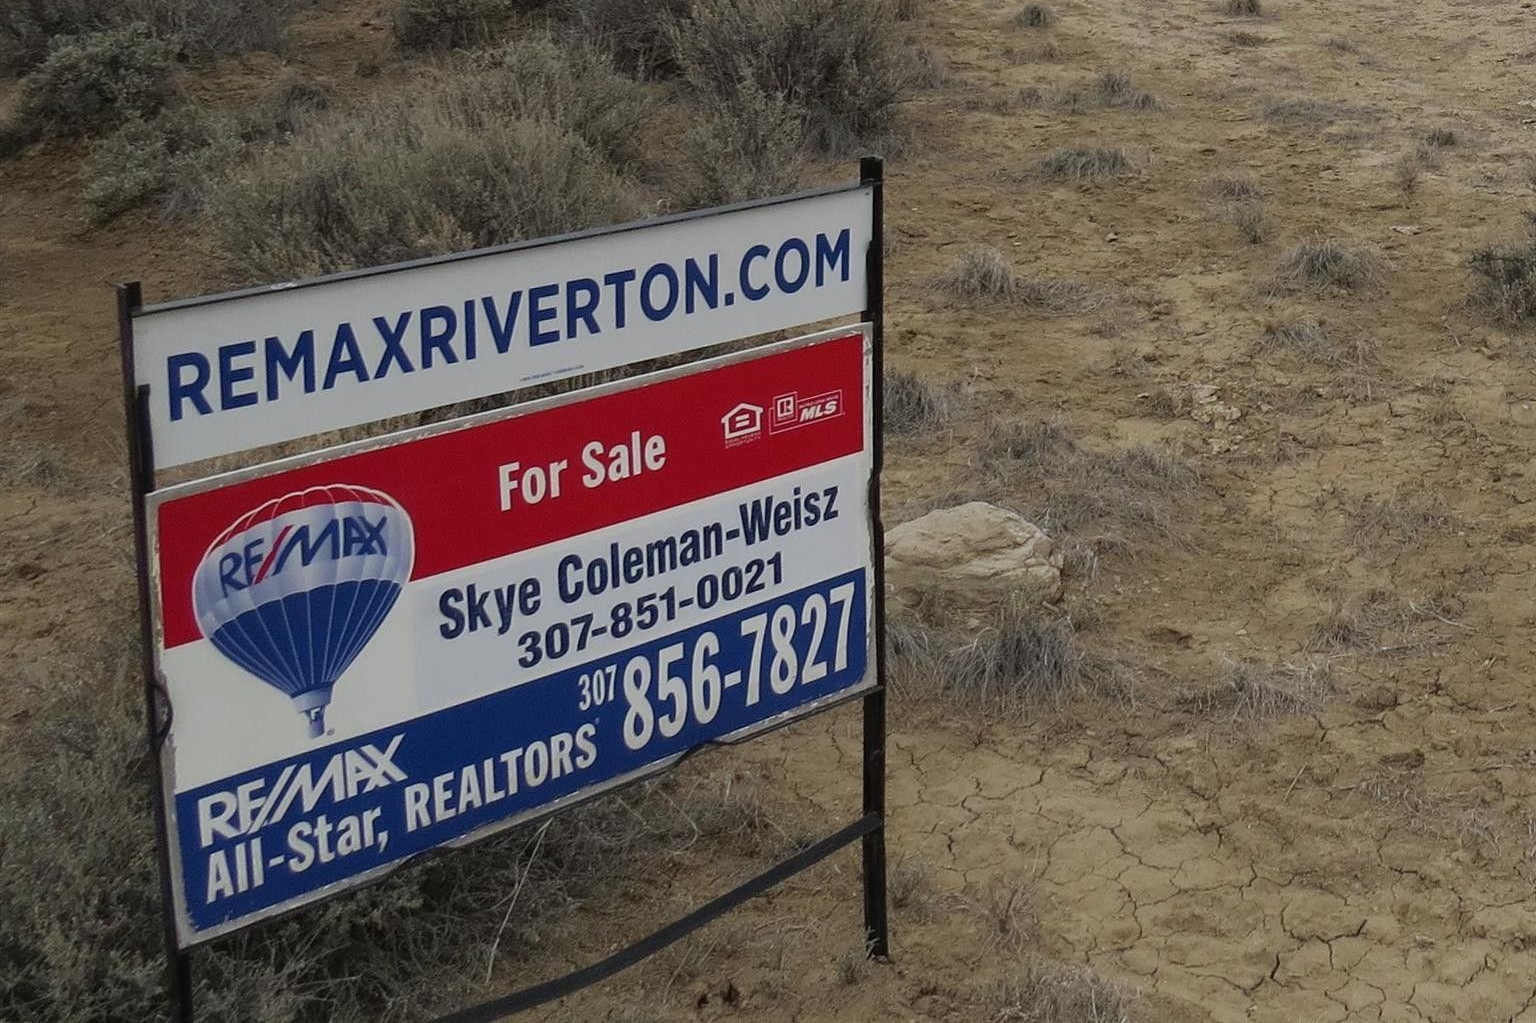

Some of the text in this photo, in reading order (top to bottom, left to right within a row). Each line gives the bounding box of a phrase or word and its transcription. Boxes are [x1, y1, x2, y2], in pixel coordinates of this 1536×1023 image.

[167, 228, 850, 421] REMAXRIVERTON.COM
[800, 401, 838, 422] MLS
[499, 430, 666, 511] For Sale
[219, 516, 387, 599] RE/MAX
[439, 485, 839, 639] Skye Coleman-Weisz
[517, 551, 782, 668] 307-851-0021
[578, 581, 855, 750] 307 856-7827
[198, 733, 408, 848] RE/MAX
[207, 806, 388, 905] All-Star,
